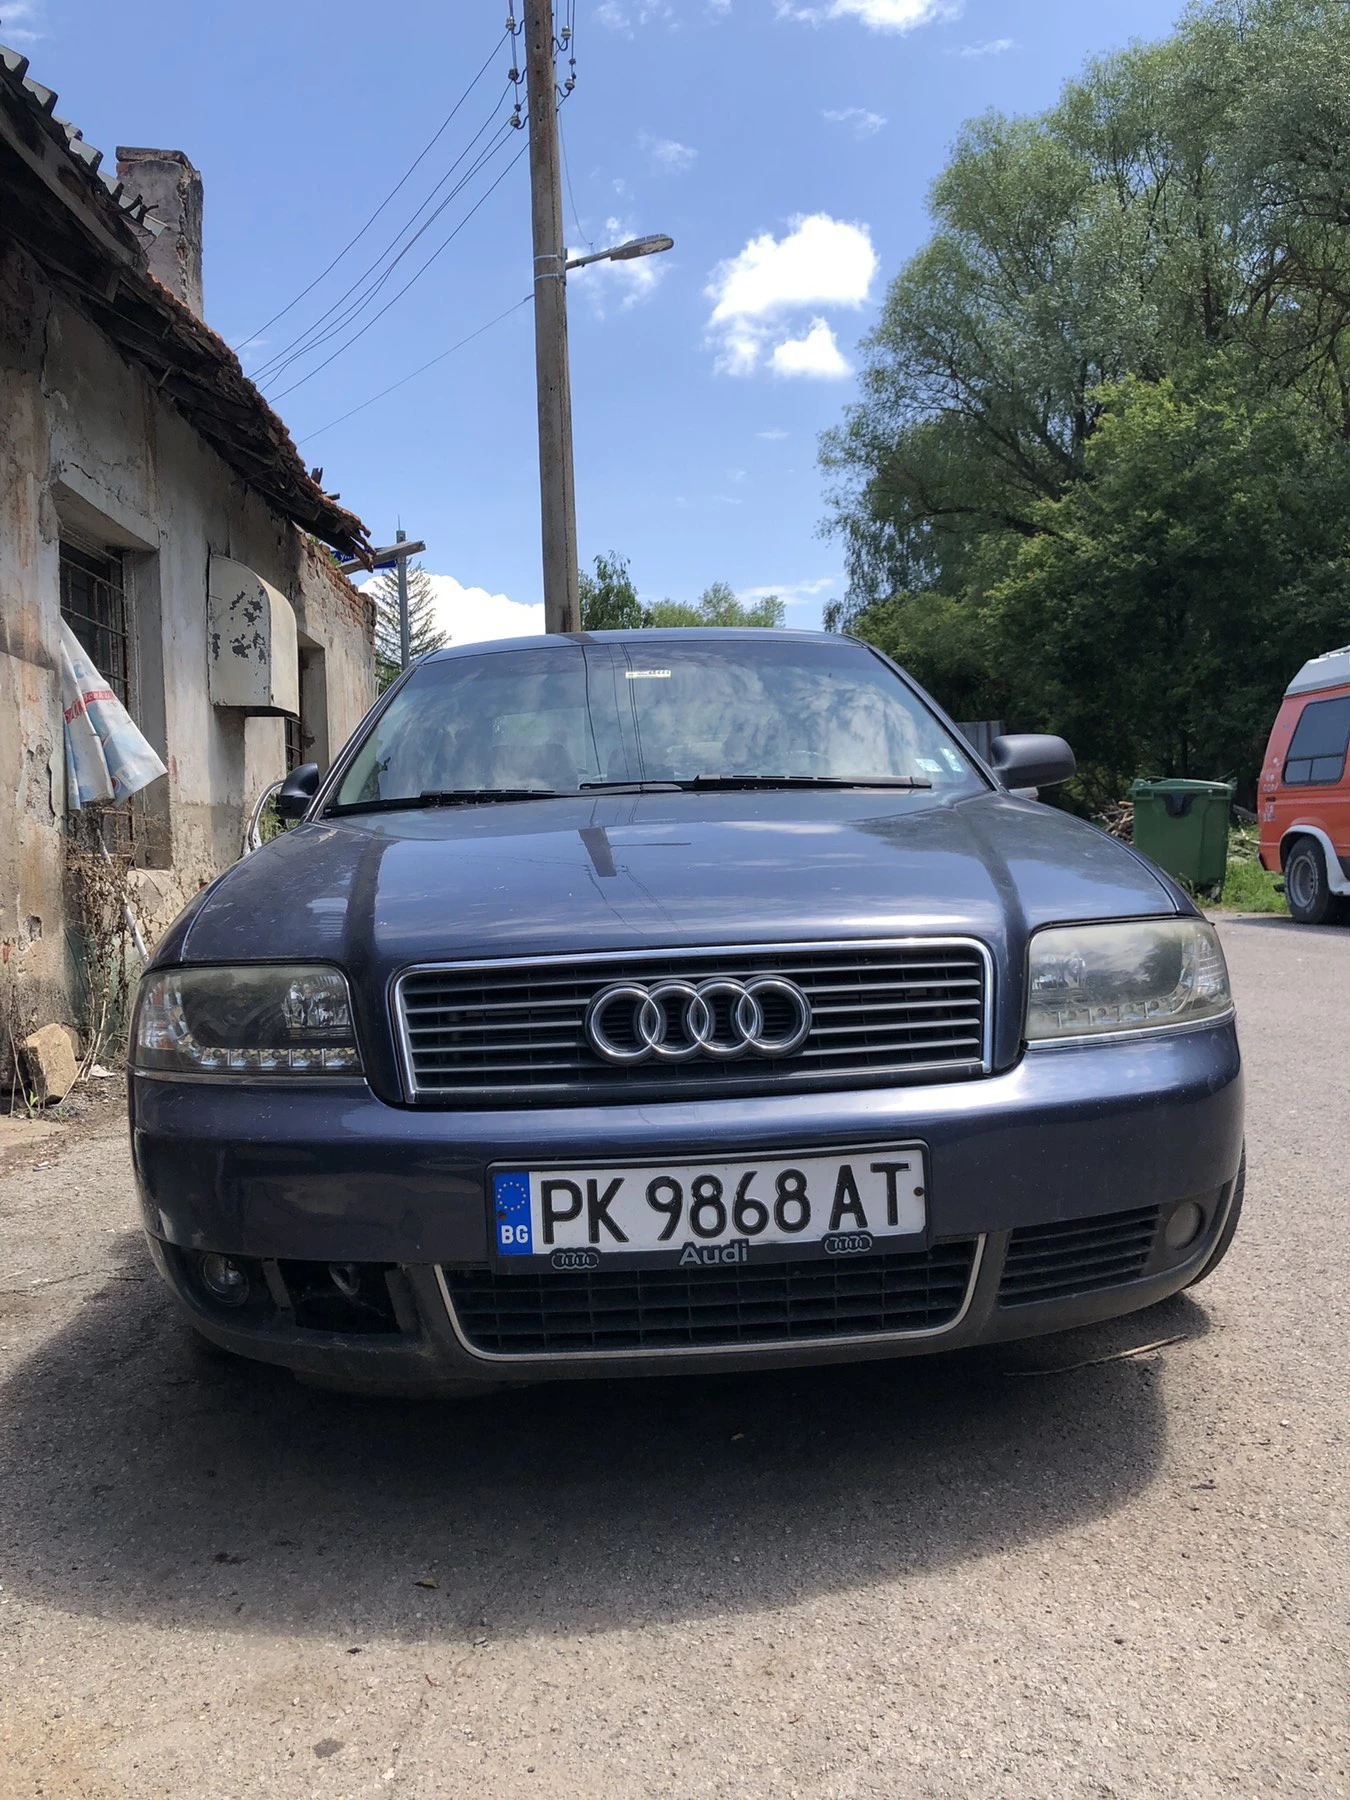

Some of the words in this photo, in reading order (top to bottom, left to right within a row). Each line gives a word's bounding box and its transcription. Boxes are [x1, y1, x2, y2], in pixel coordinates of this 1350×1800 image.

[541, 1178, 629, 1244] PK
[646, 1168, 811, 1240] 9868
[829, 1162, 911, 1230] AT
[501, 1225, 528, 1245] BG
[679, 1243, 748, 1266] Audi
